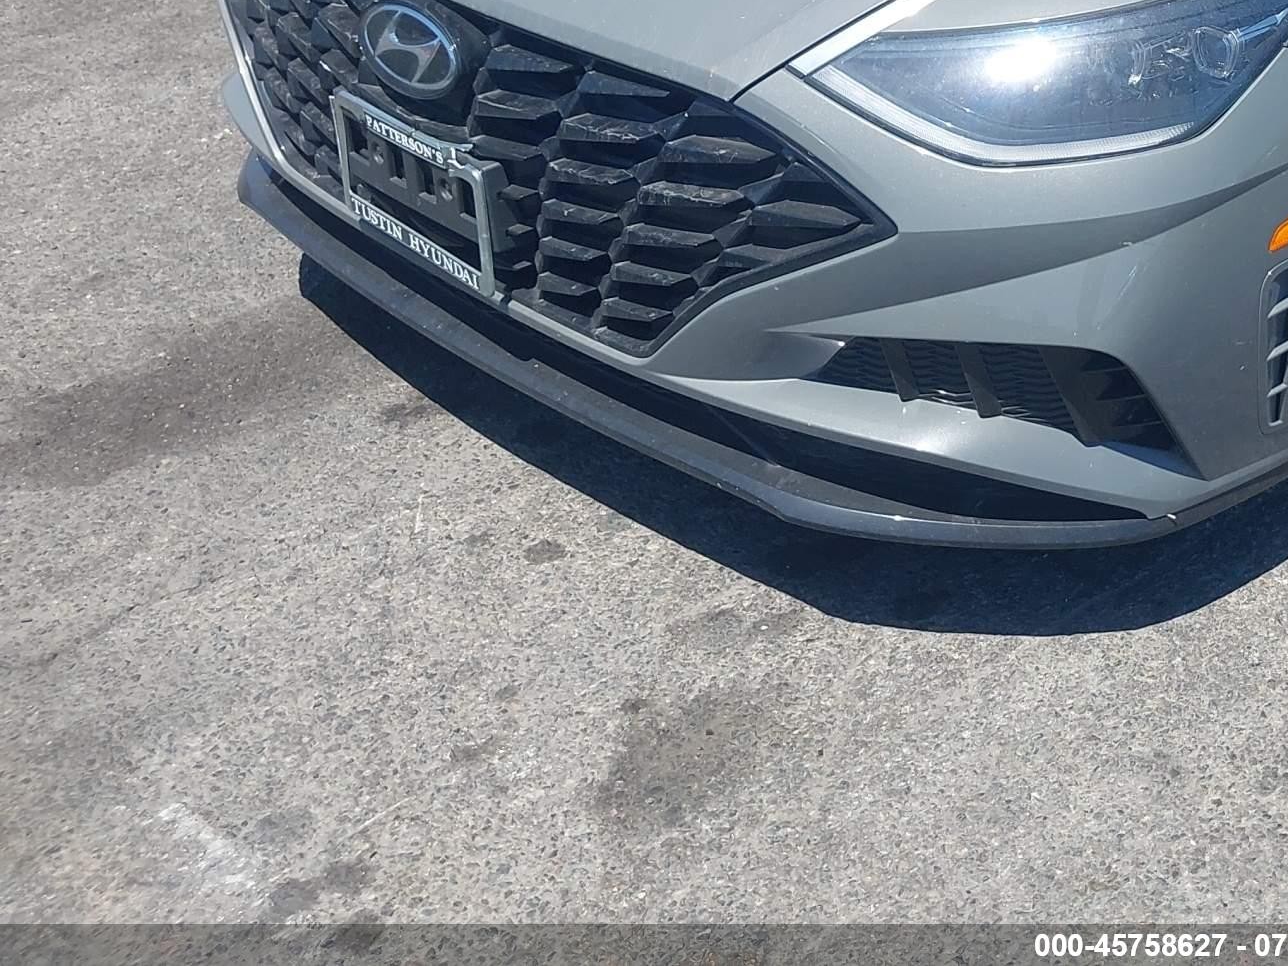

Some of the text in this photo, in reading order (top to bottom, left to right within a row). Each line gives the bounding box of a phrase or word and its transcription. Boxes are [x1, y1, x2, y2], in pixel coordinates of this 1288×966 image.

[366, 115, 444, 164] PATTERSON'S
[352, 199, 481, 291] TUSTIN HYUNDAI
